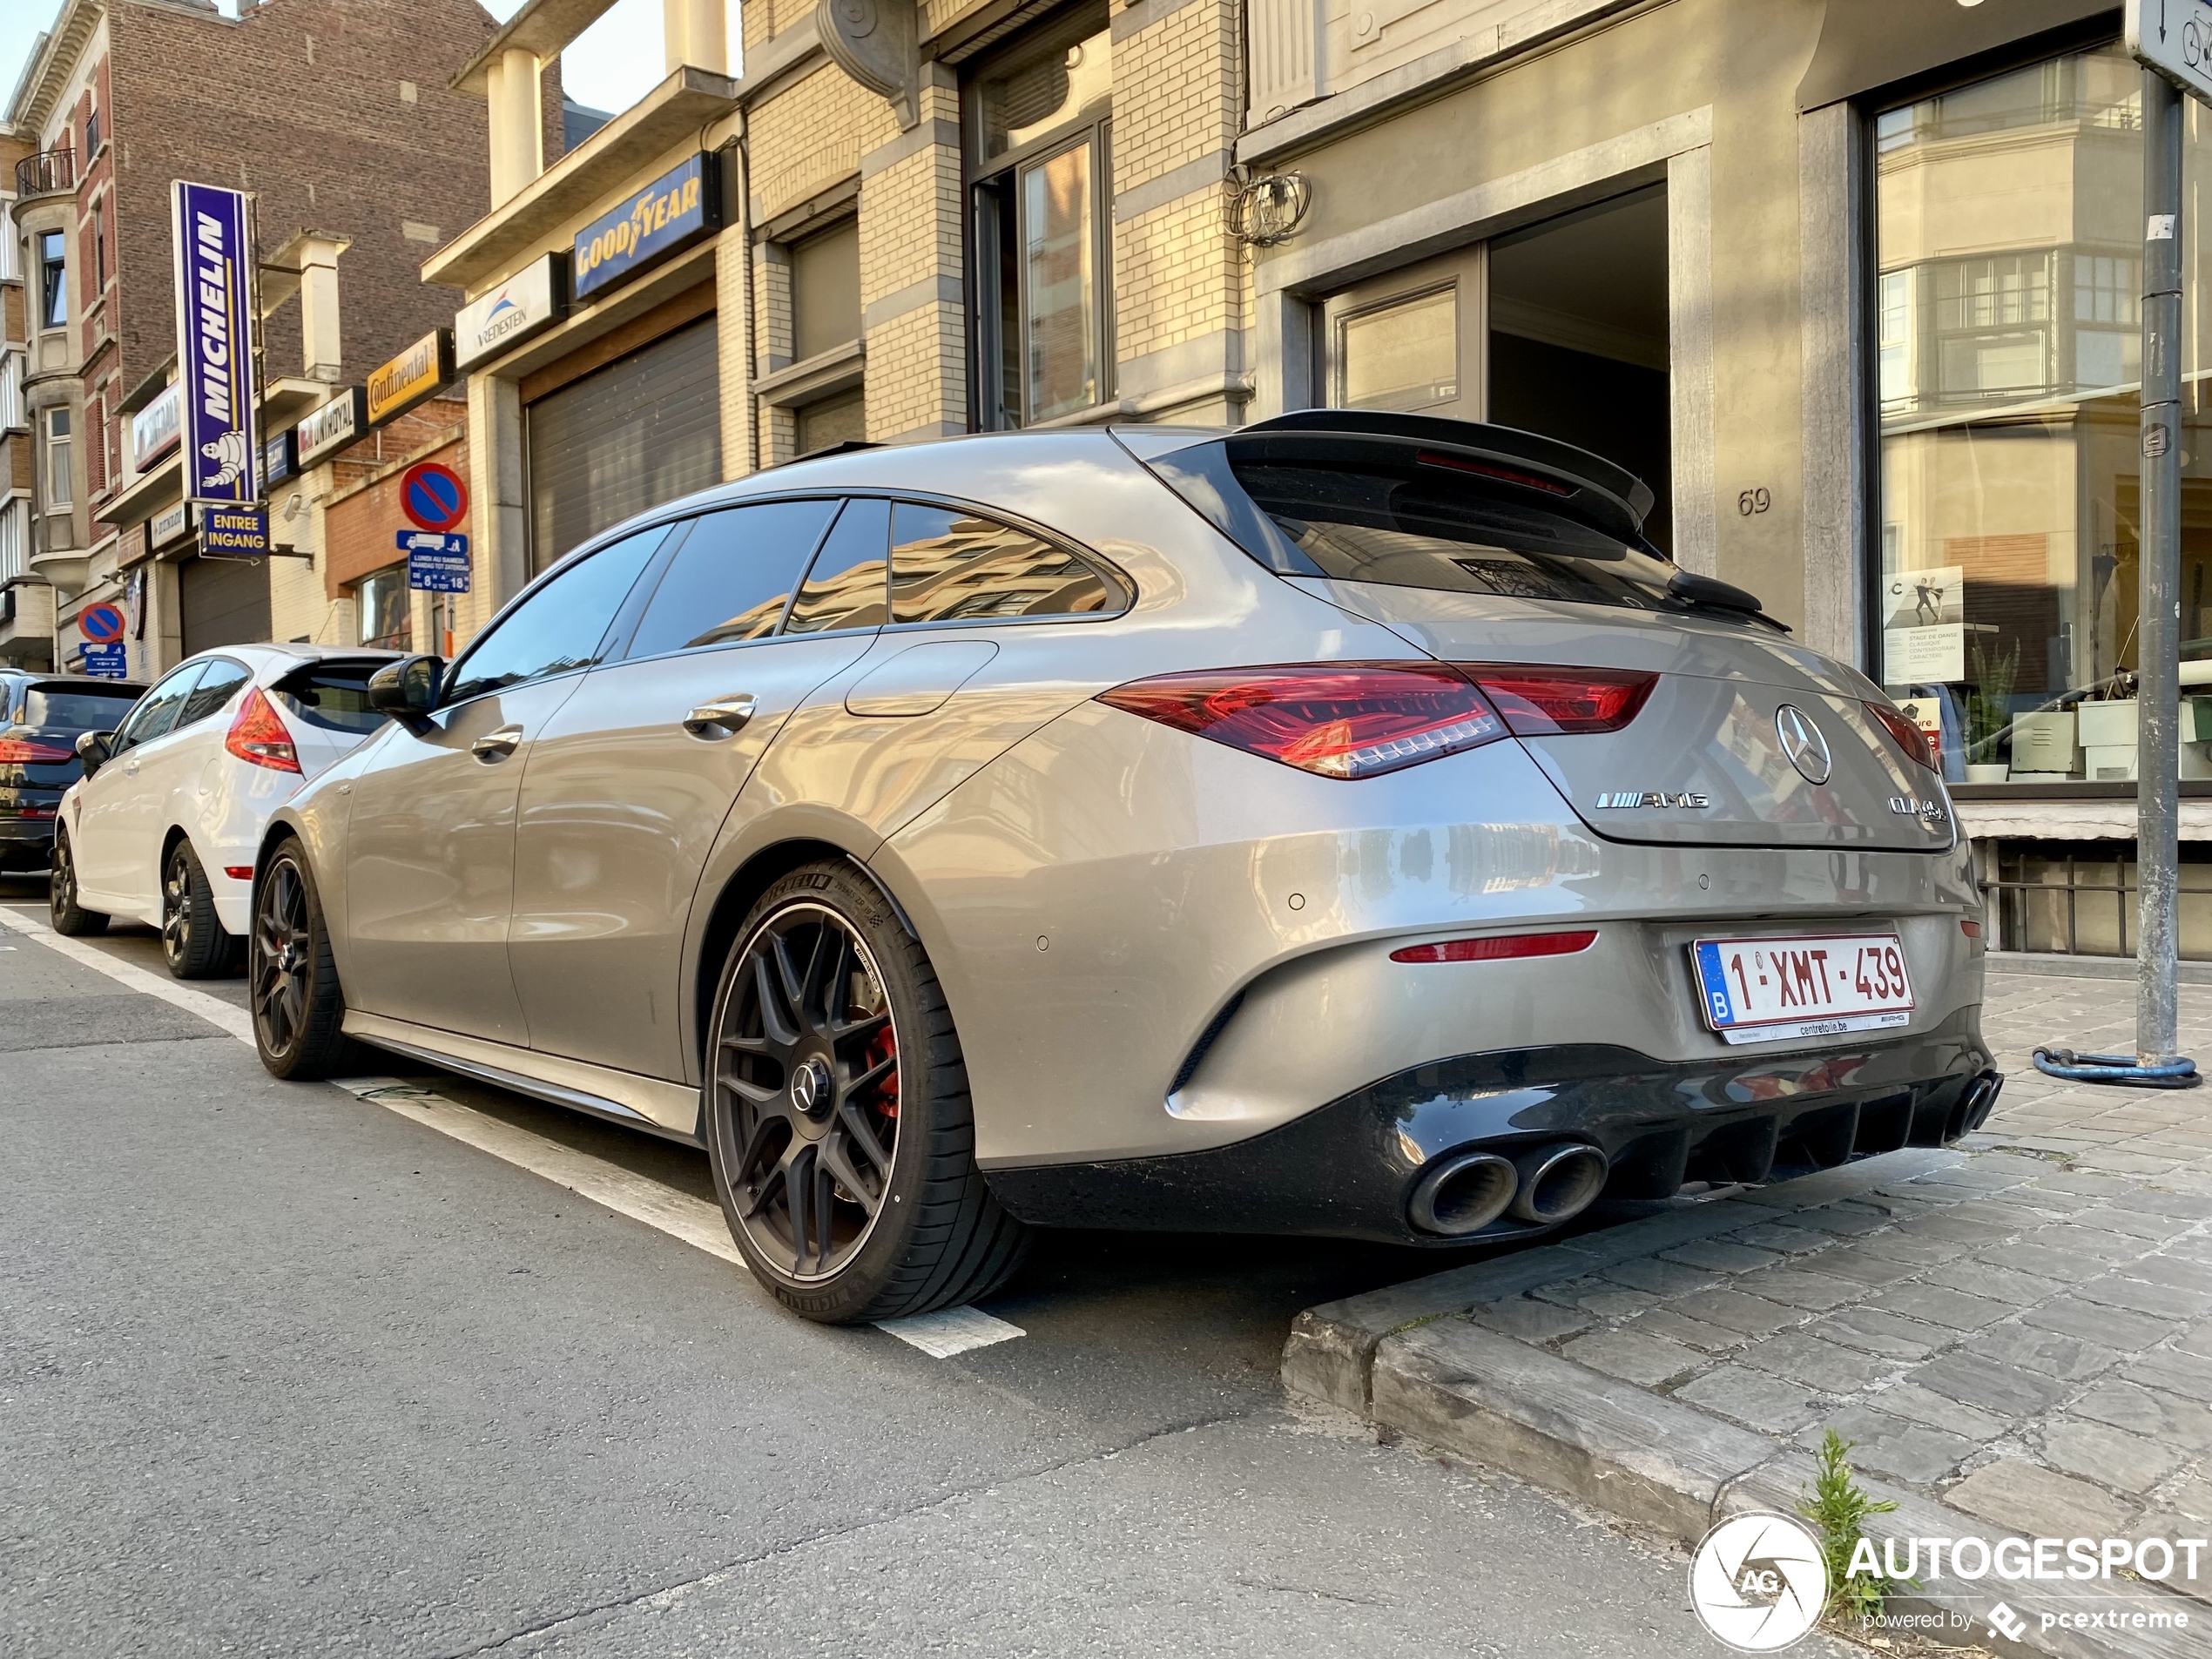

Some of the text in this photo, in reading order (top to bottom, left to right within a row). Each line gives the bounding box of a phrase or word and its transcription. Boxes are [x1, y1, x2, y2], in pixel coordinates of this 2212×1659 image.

[577, 177, 699, 277] GOODYEAR
[197, 211, 230, 423] MICHELIN
[478, 307, 527, 347] VREDESTEIN
[370, 344, 429, 414] Continental
[314, 399, 353, 446] UNIROYAL
[1738, 487, 1770, 516] 69
[213, 514, 259, 530] ENTREE
[208, 532, 265, 549] INGANG
[424, 575, 431, 587] 8
[451, 577, 463, 589] 18
[1909, 645, 1956, 654] CONTEMPORAIN
[1635, 792, 1710, 808] AMG
[1712, 991, 1728, 1018] B
[1800, 1021, 1847, 1035] centretoile.be
